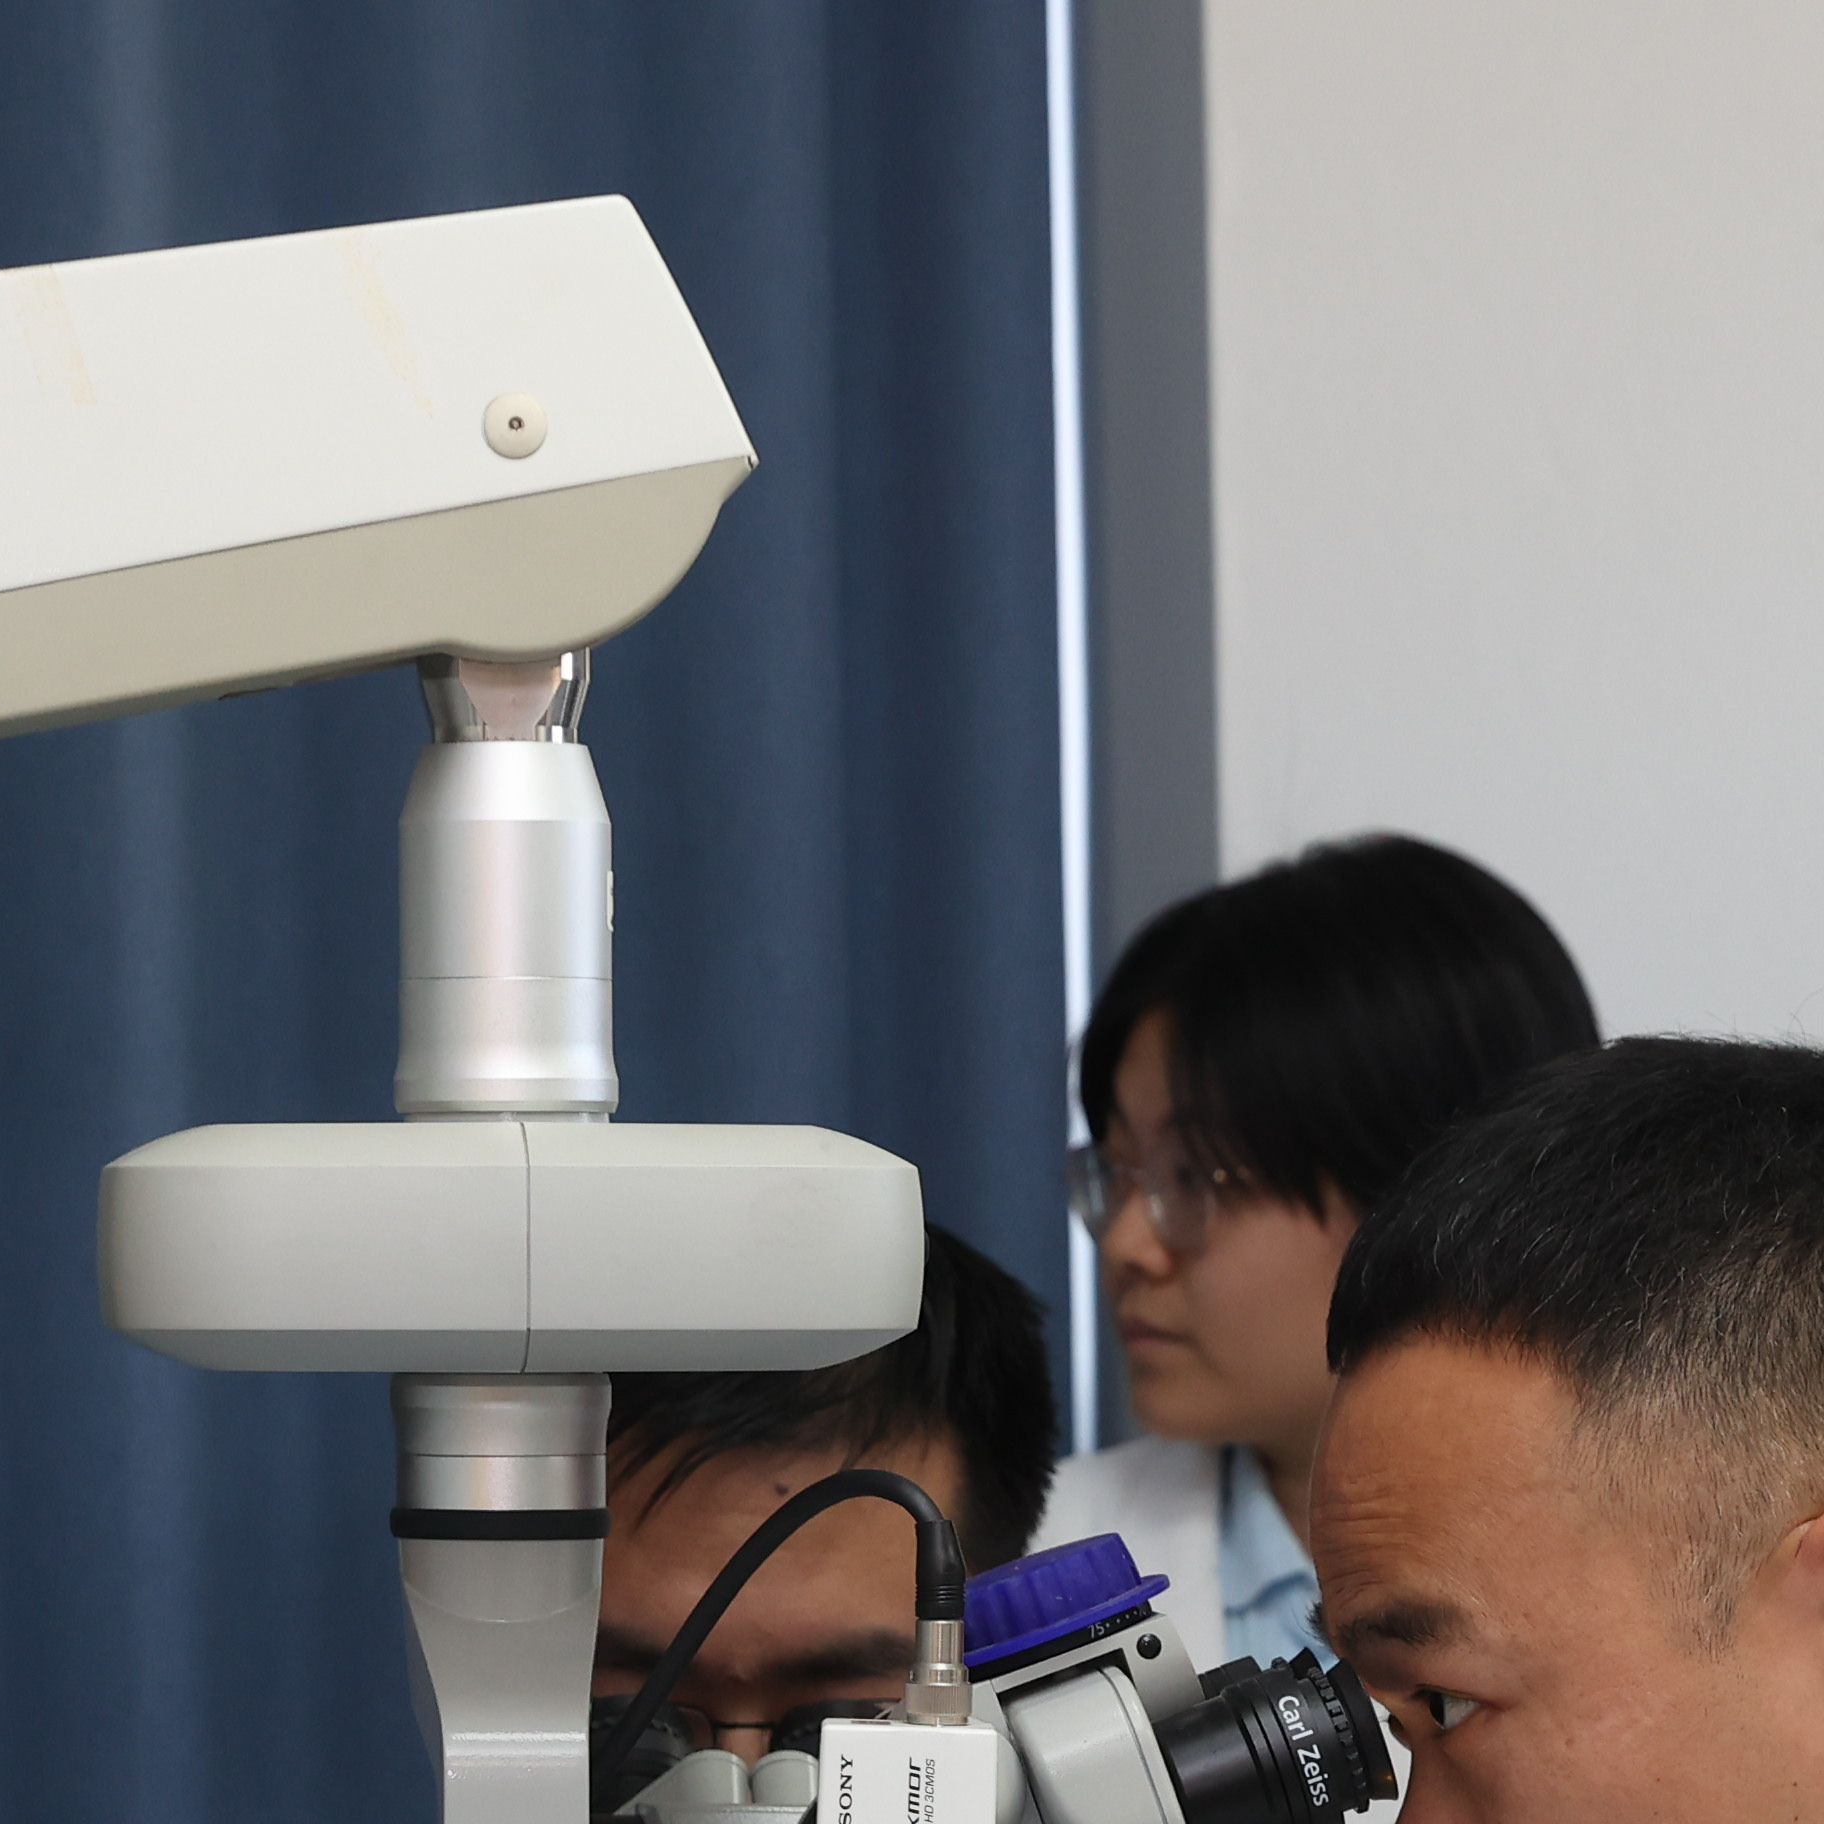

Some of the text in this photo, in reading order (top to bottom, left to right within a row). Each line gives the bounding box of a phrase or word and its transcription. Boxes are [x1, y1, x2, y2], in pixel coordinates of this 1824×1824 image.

[1088, 1621, 1105, 1639] 75
[1278, 1695, 1329, 1807] Carl Zeiss
[924, 1758, 936, 1803] 3CMOS
[924, 1804, 934, 1823] HD
